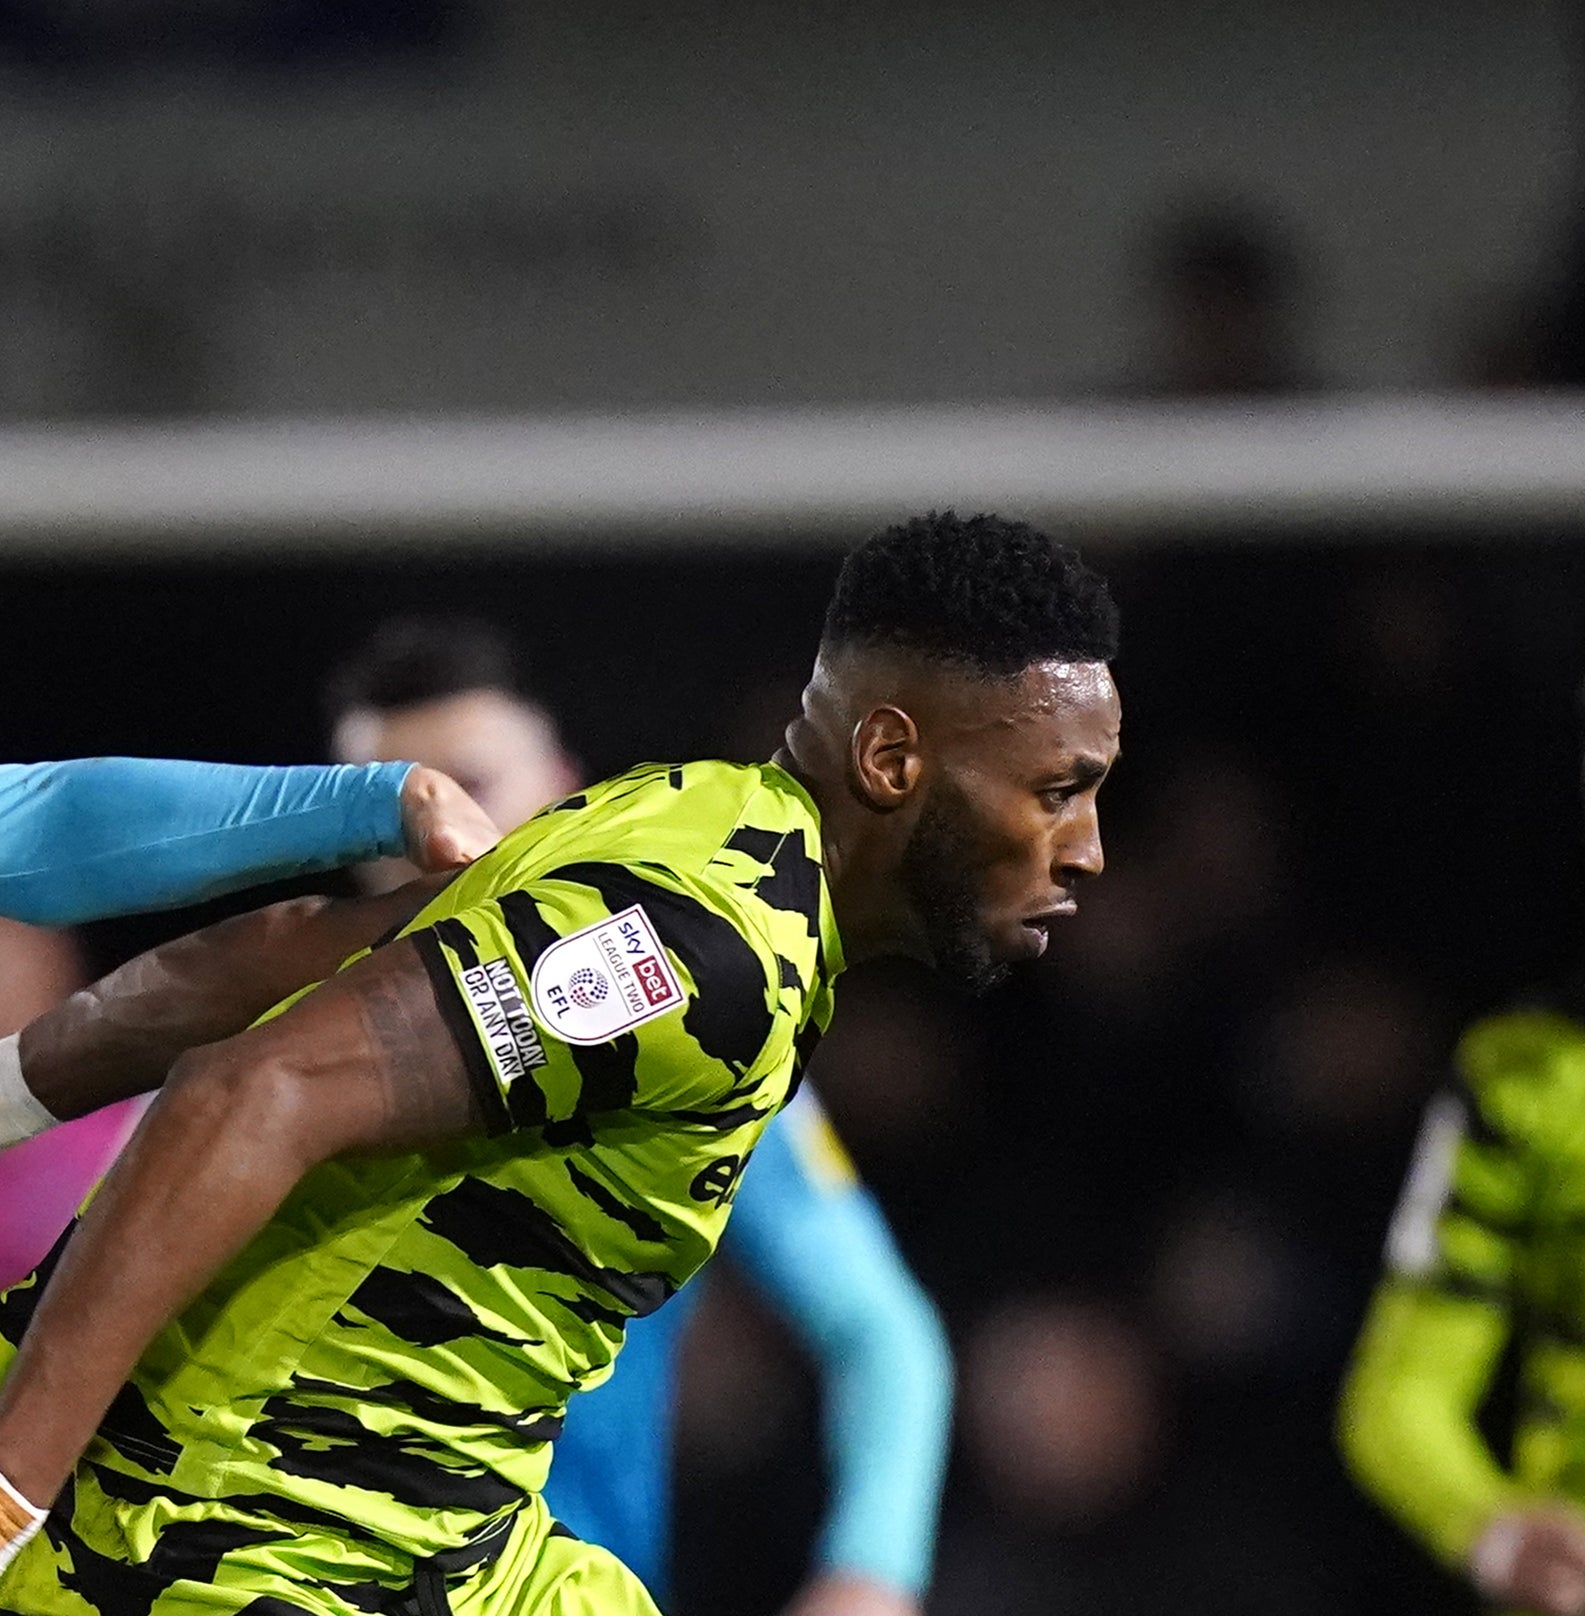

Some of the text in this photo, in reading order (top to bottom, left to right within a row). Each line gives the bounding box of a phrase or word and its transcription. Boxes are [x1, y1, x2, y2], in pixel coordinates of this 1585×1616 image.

[546, 984, 571, 1019] EFL
[598, 931, 646, 1014] LEAGUE TWO
[618, 921, 669, 1002] sky bet
[464, 969, 524, 1078] OR ANY DAY
[484, 958, 547, 1069] NOT TODAY
